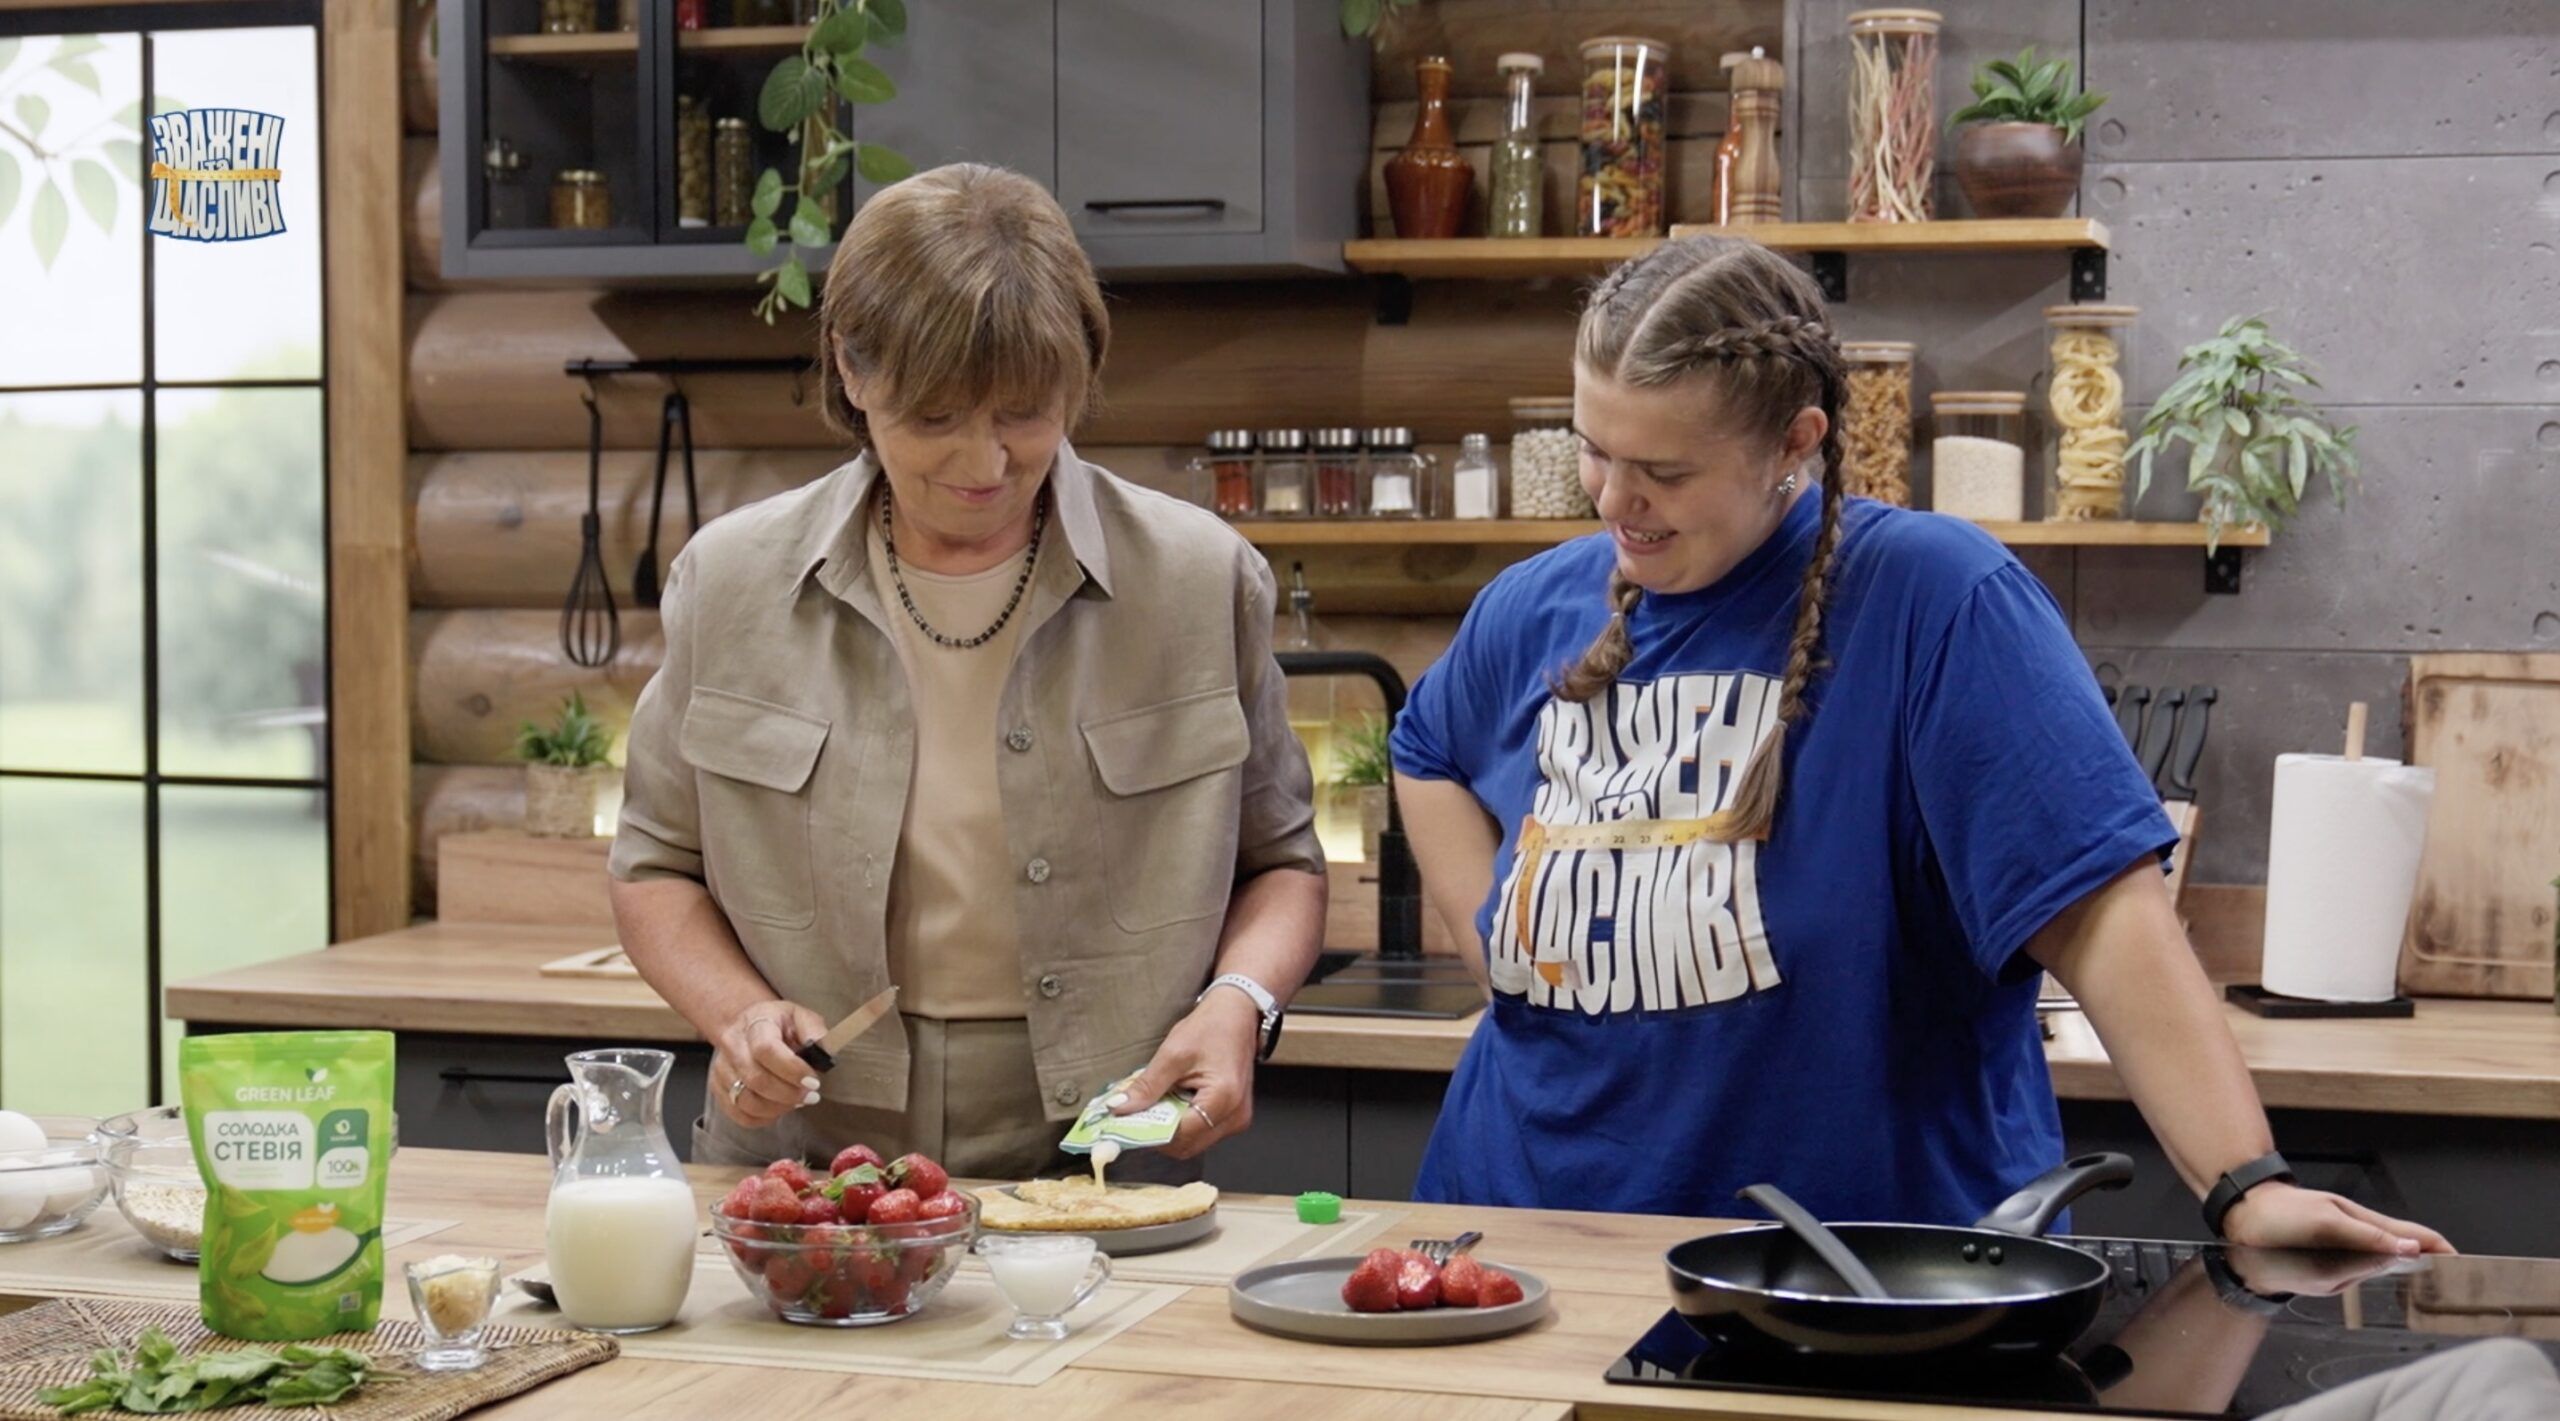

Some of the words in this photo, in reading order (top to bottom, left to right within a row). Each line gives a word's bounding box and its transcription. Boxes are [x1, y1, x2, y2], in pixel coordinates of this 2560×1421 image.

[236, 1086, 292, 1102] GREEN
[296, 1086, 335, 1101] LEAF
[218, 1122, 299, 1137] СОЛОДКА
[214, 1141, 302, 1161] СТЕВІЯ
